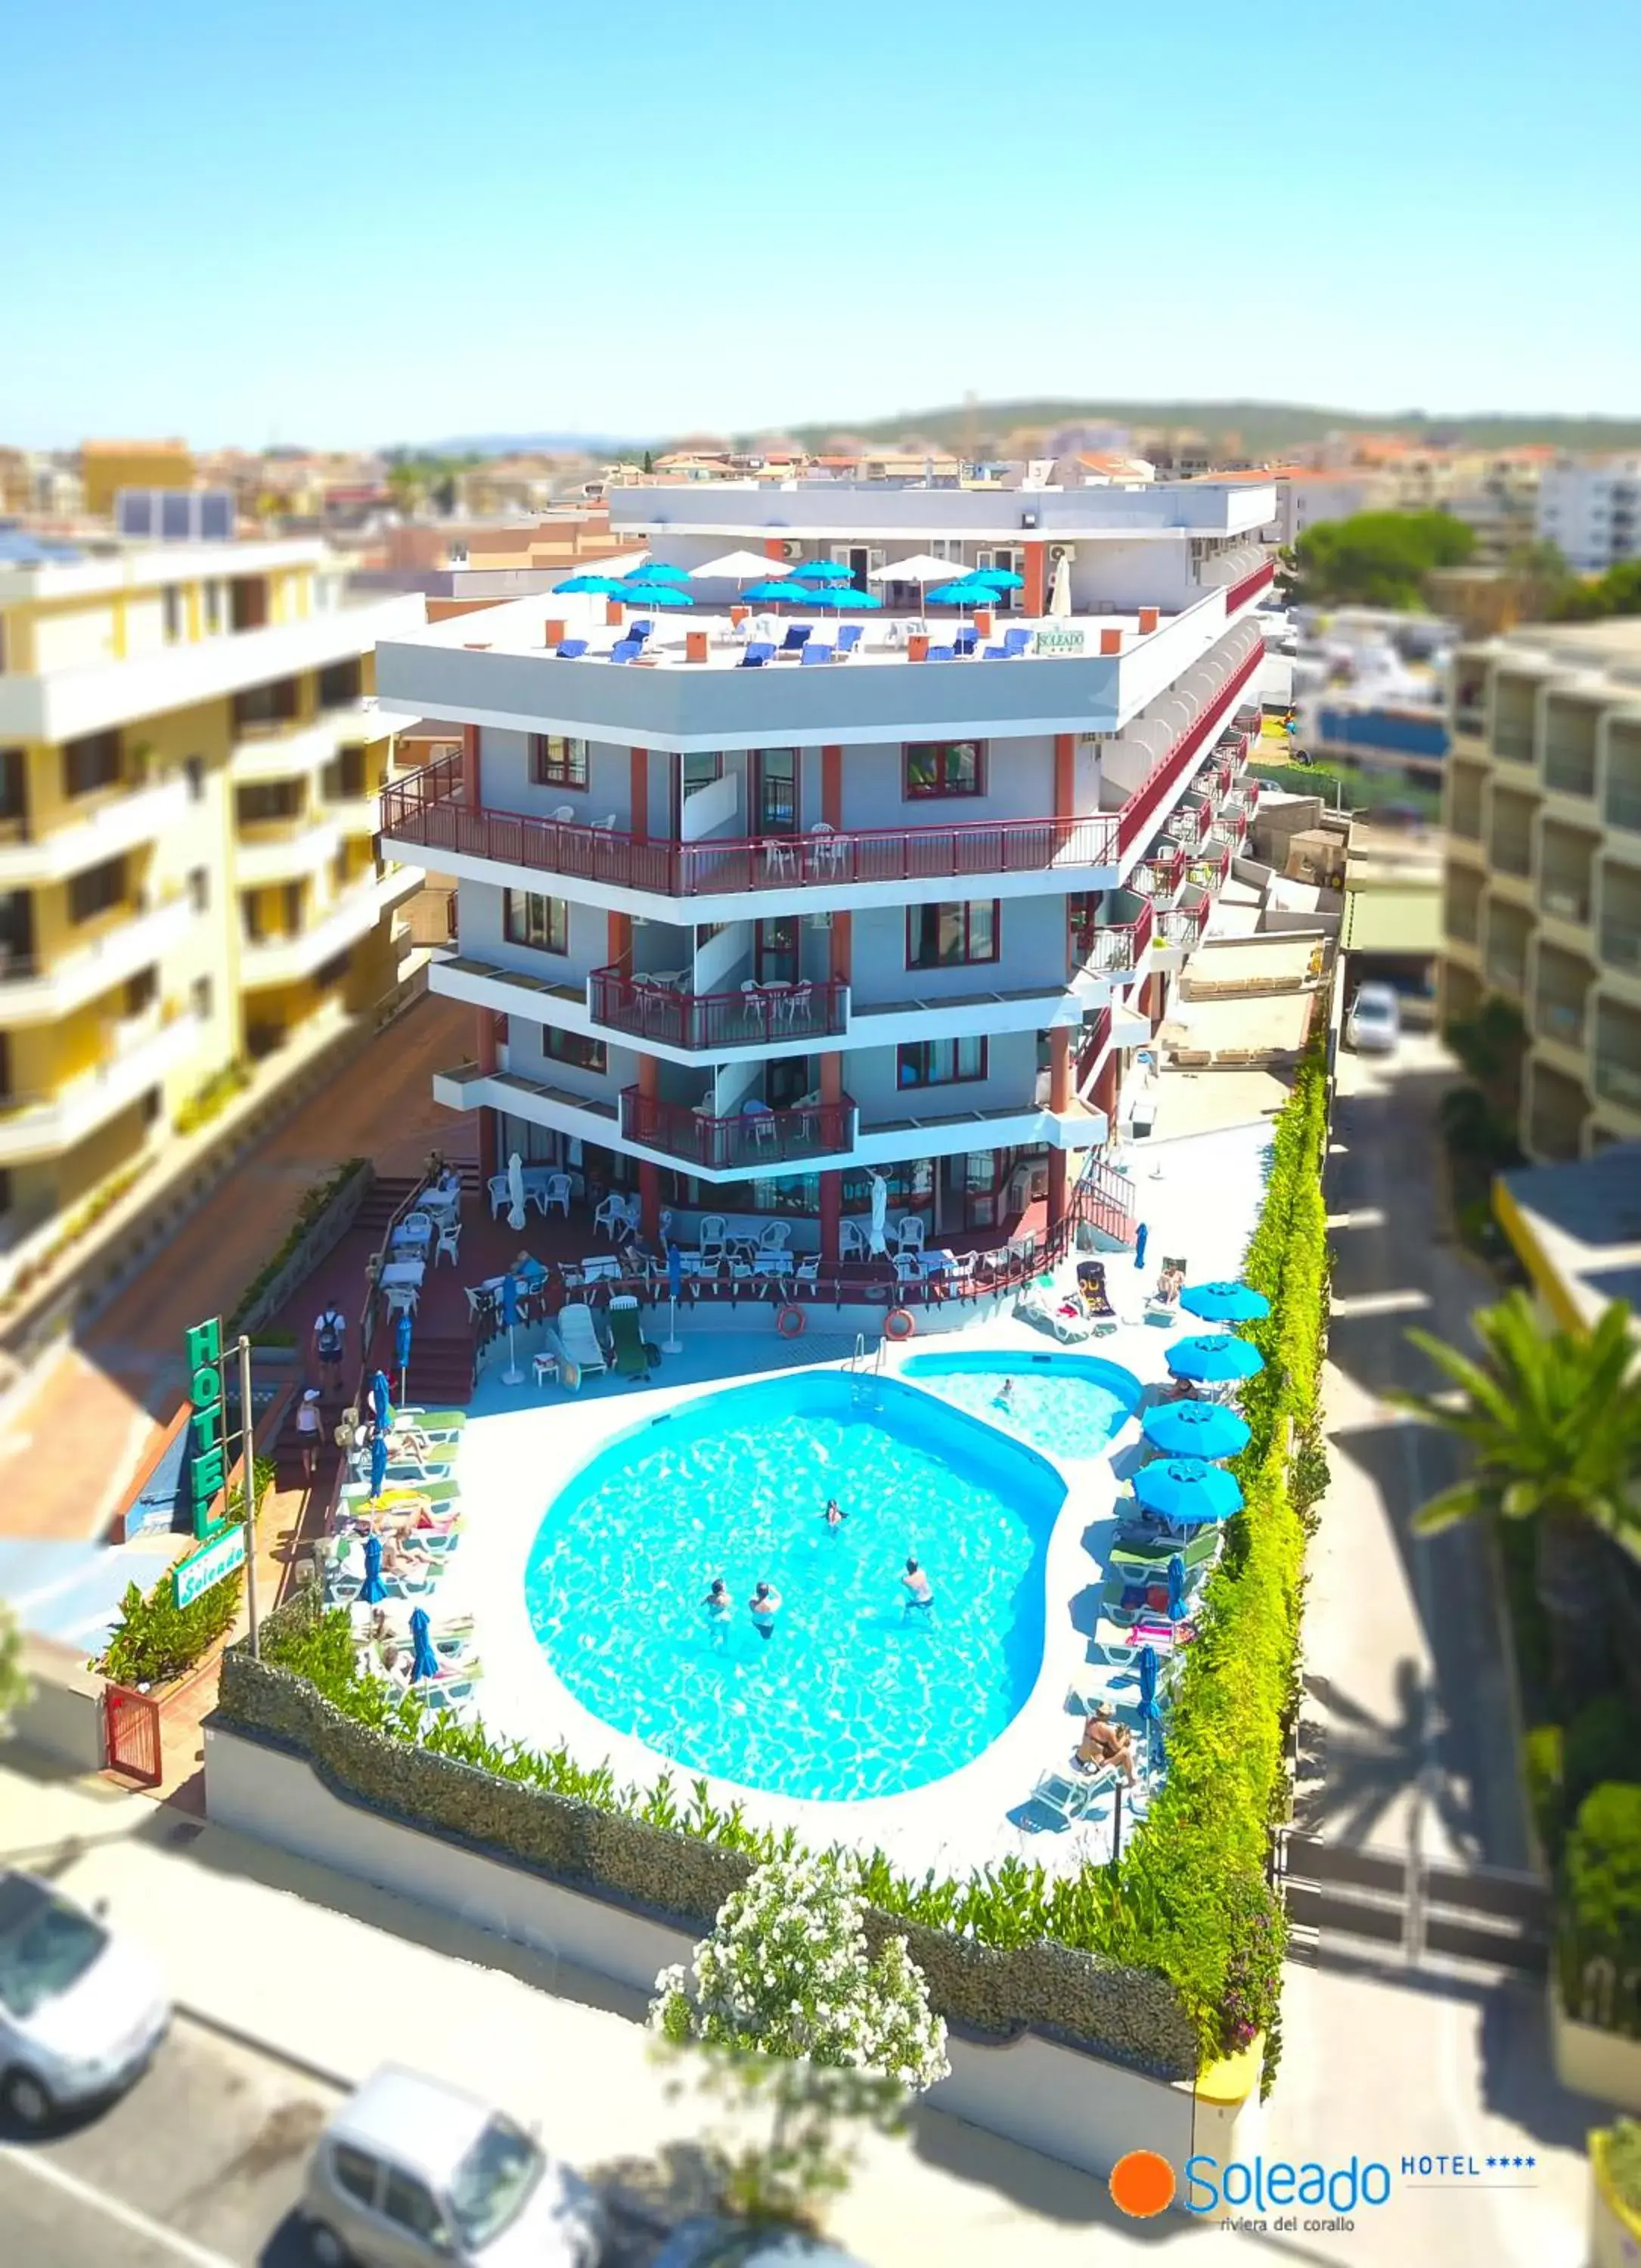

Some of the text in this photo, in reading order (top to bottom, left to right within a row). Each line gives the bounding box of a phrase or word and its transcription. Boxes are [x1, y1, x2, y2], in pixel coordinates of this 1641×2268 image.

[1041, 631, 1084, 646] SOLEADO
[187, 1317, 225, 1541] HOTEL
[181, 1548, 243, 1603] Soleado
